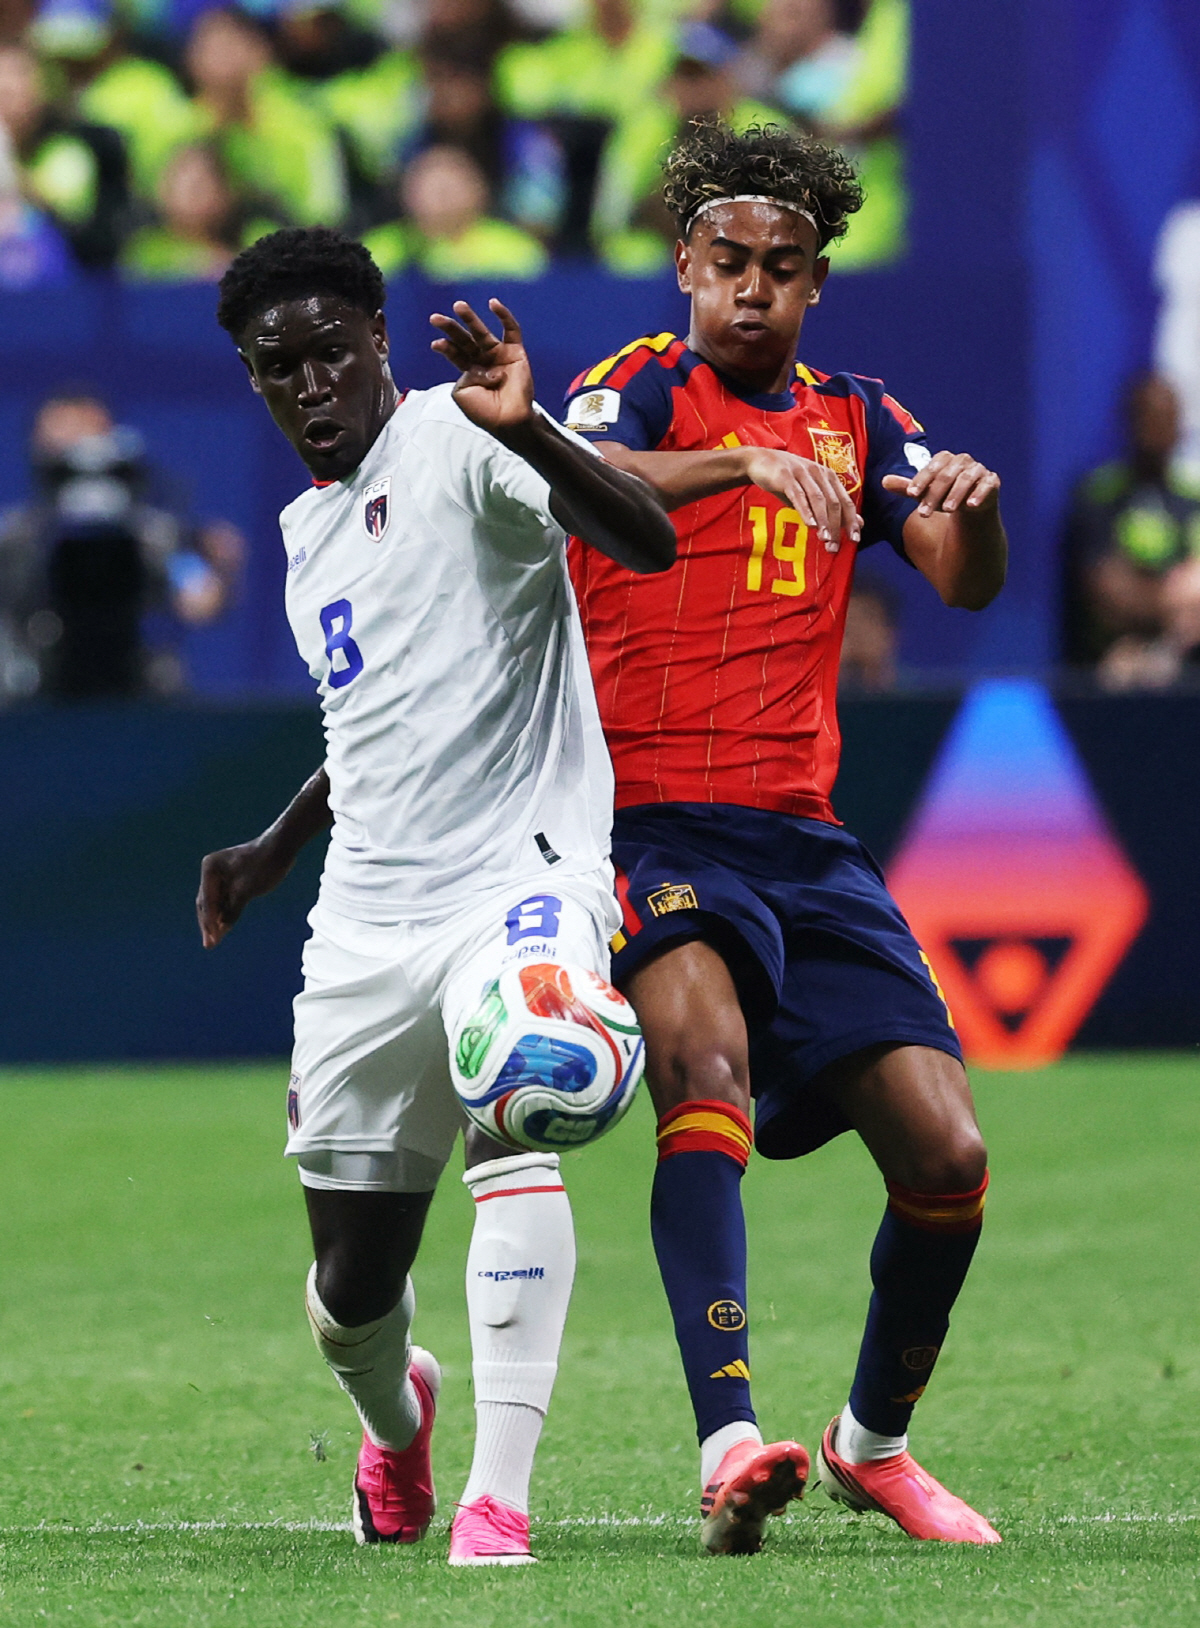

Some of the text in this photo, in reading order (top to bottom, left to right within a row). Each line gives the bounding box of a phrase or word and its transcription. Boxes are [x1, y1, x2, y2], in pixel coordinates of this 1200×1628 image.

[365, 480, 388, 497] FCF
[747, 506, 808, 597] 19
[319, 598, 364, 690] 8
[504, 895, 563, 946] 8
